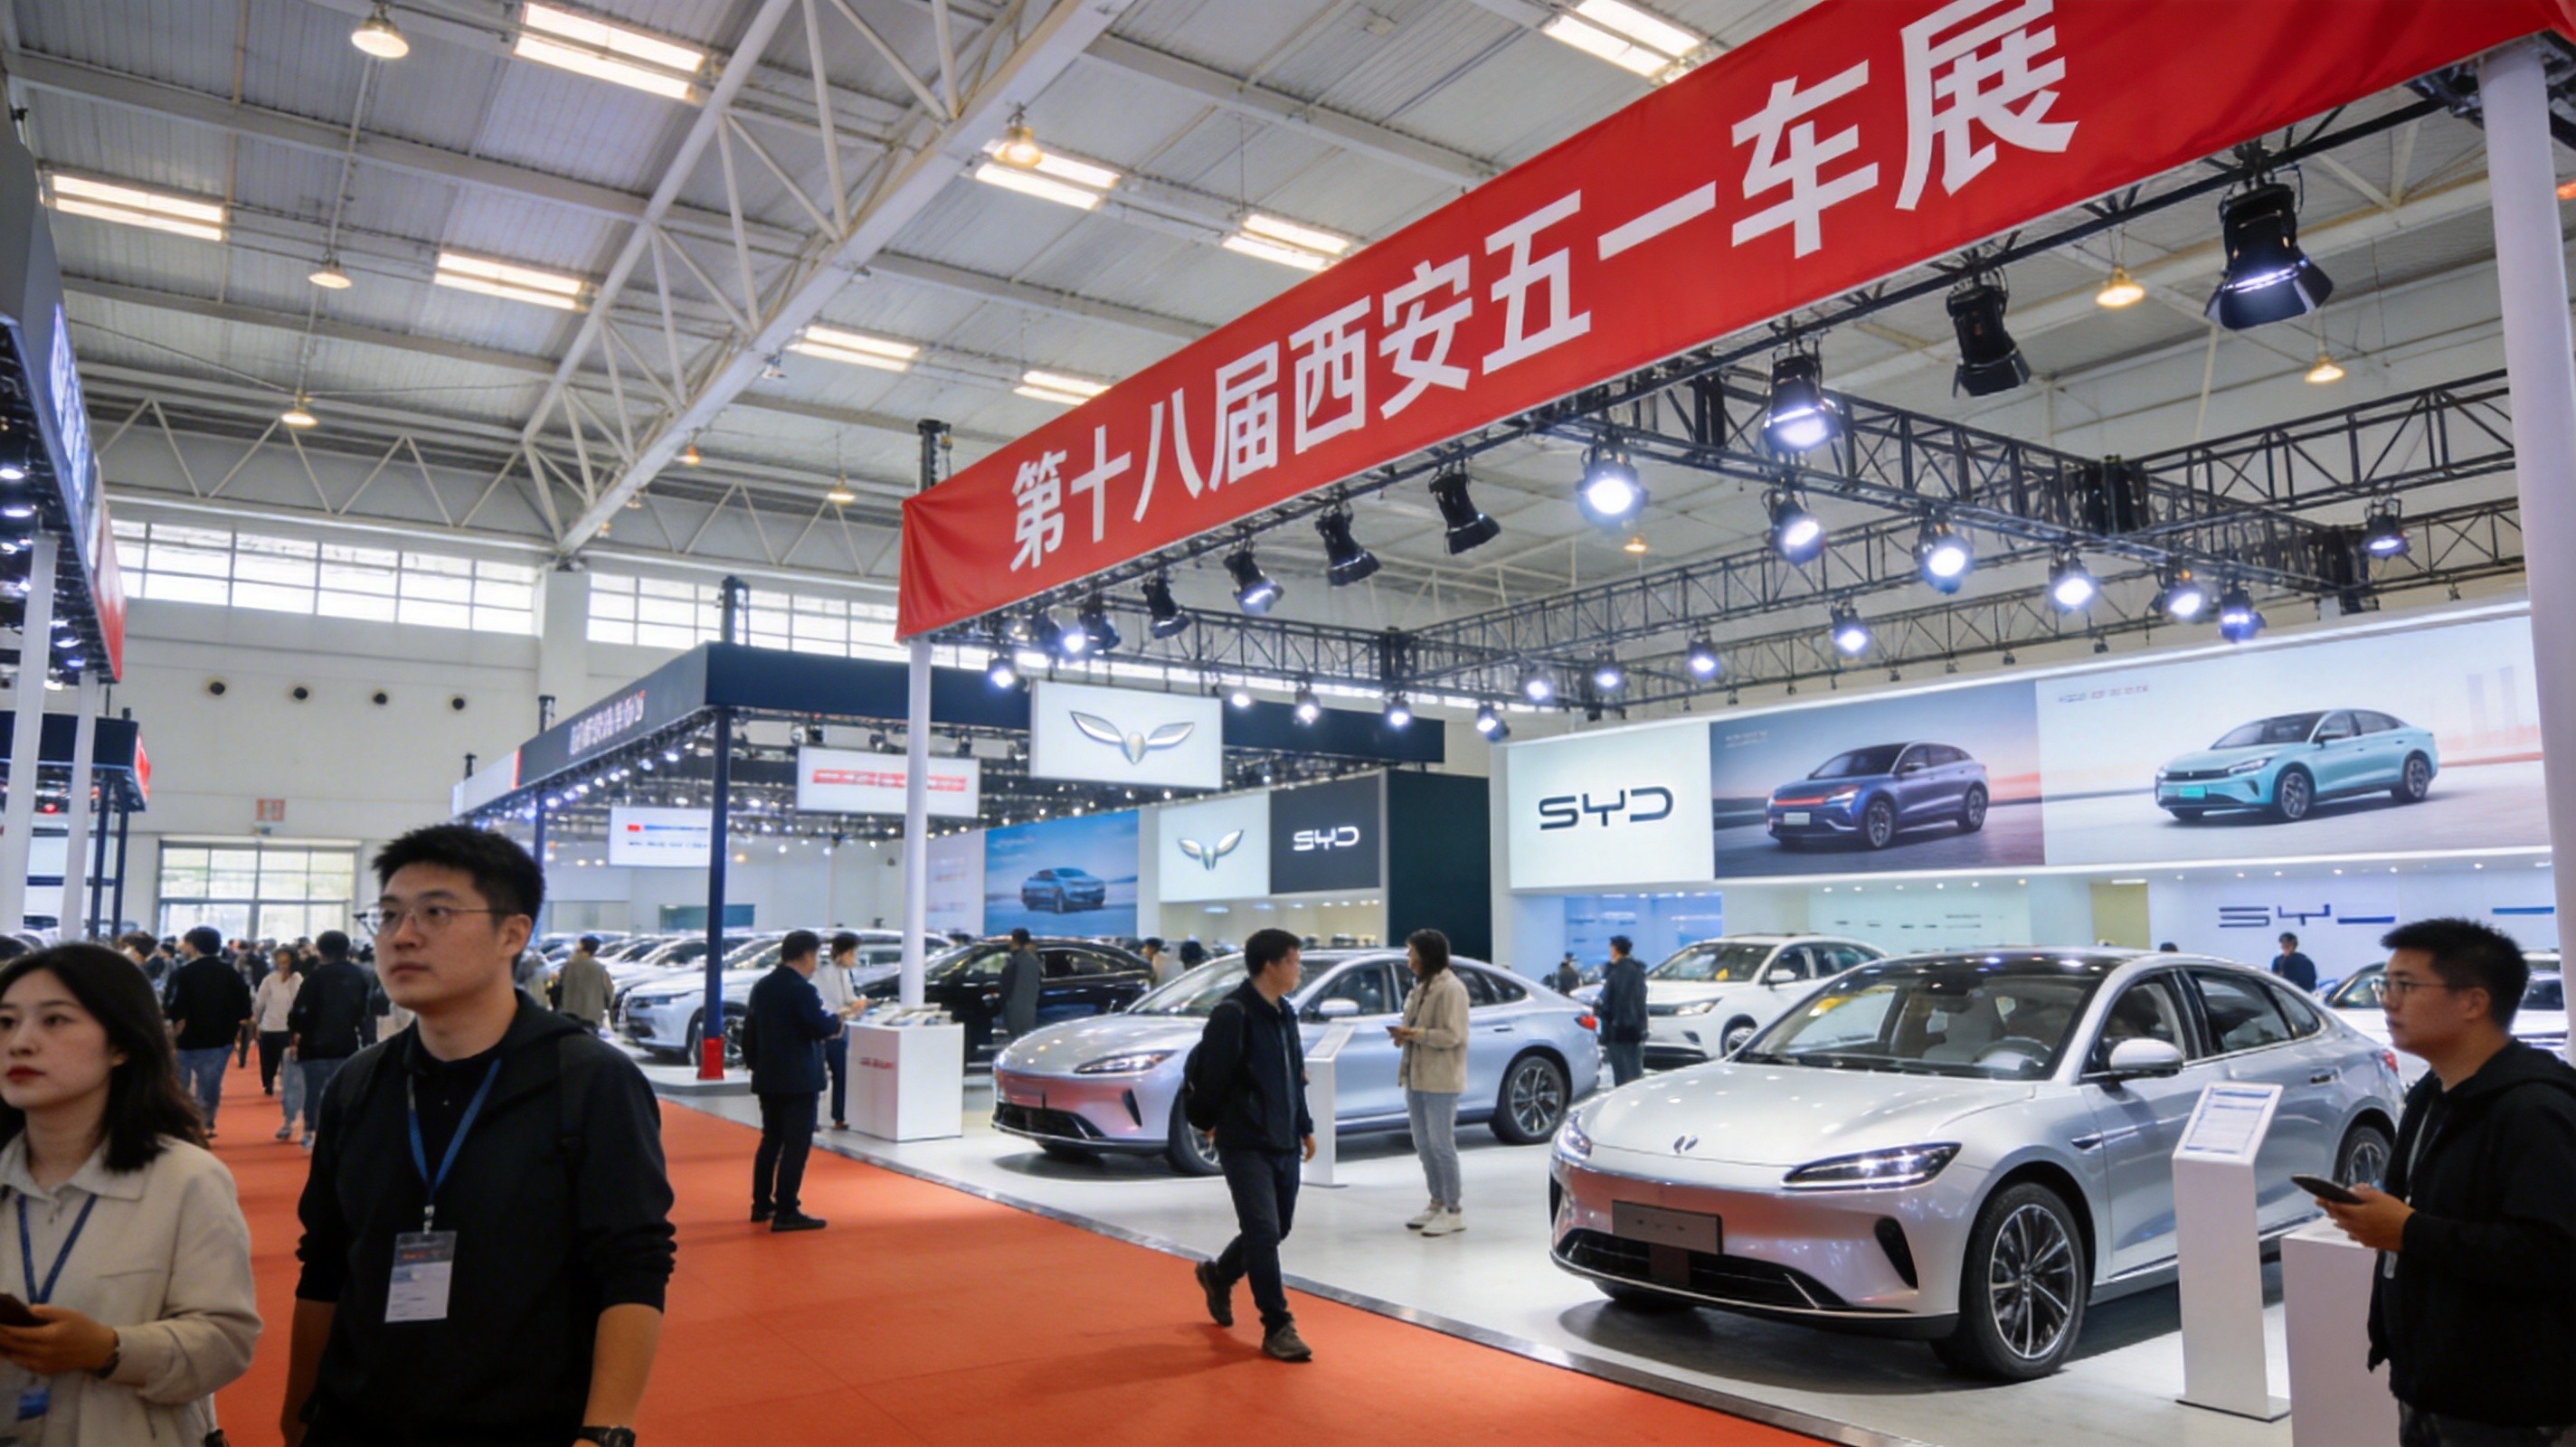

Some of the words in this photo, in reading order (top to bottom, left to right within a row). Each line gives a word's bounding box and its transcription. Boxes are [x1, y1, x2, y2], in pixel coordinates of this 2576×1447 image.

[1010, 0, 2079, 572] 第十八届西安五一车展
